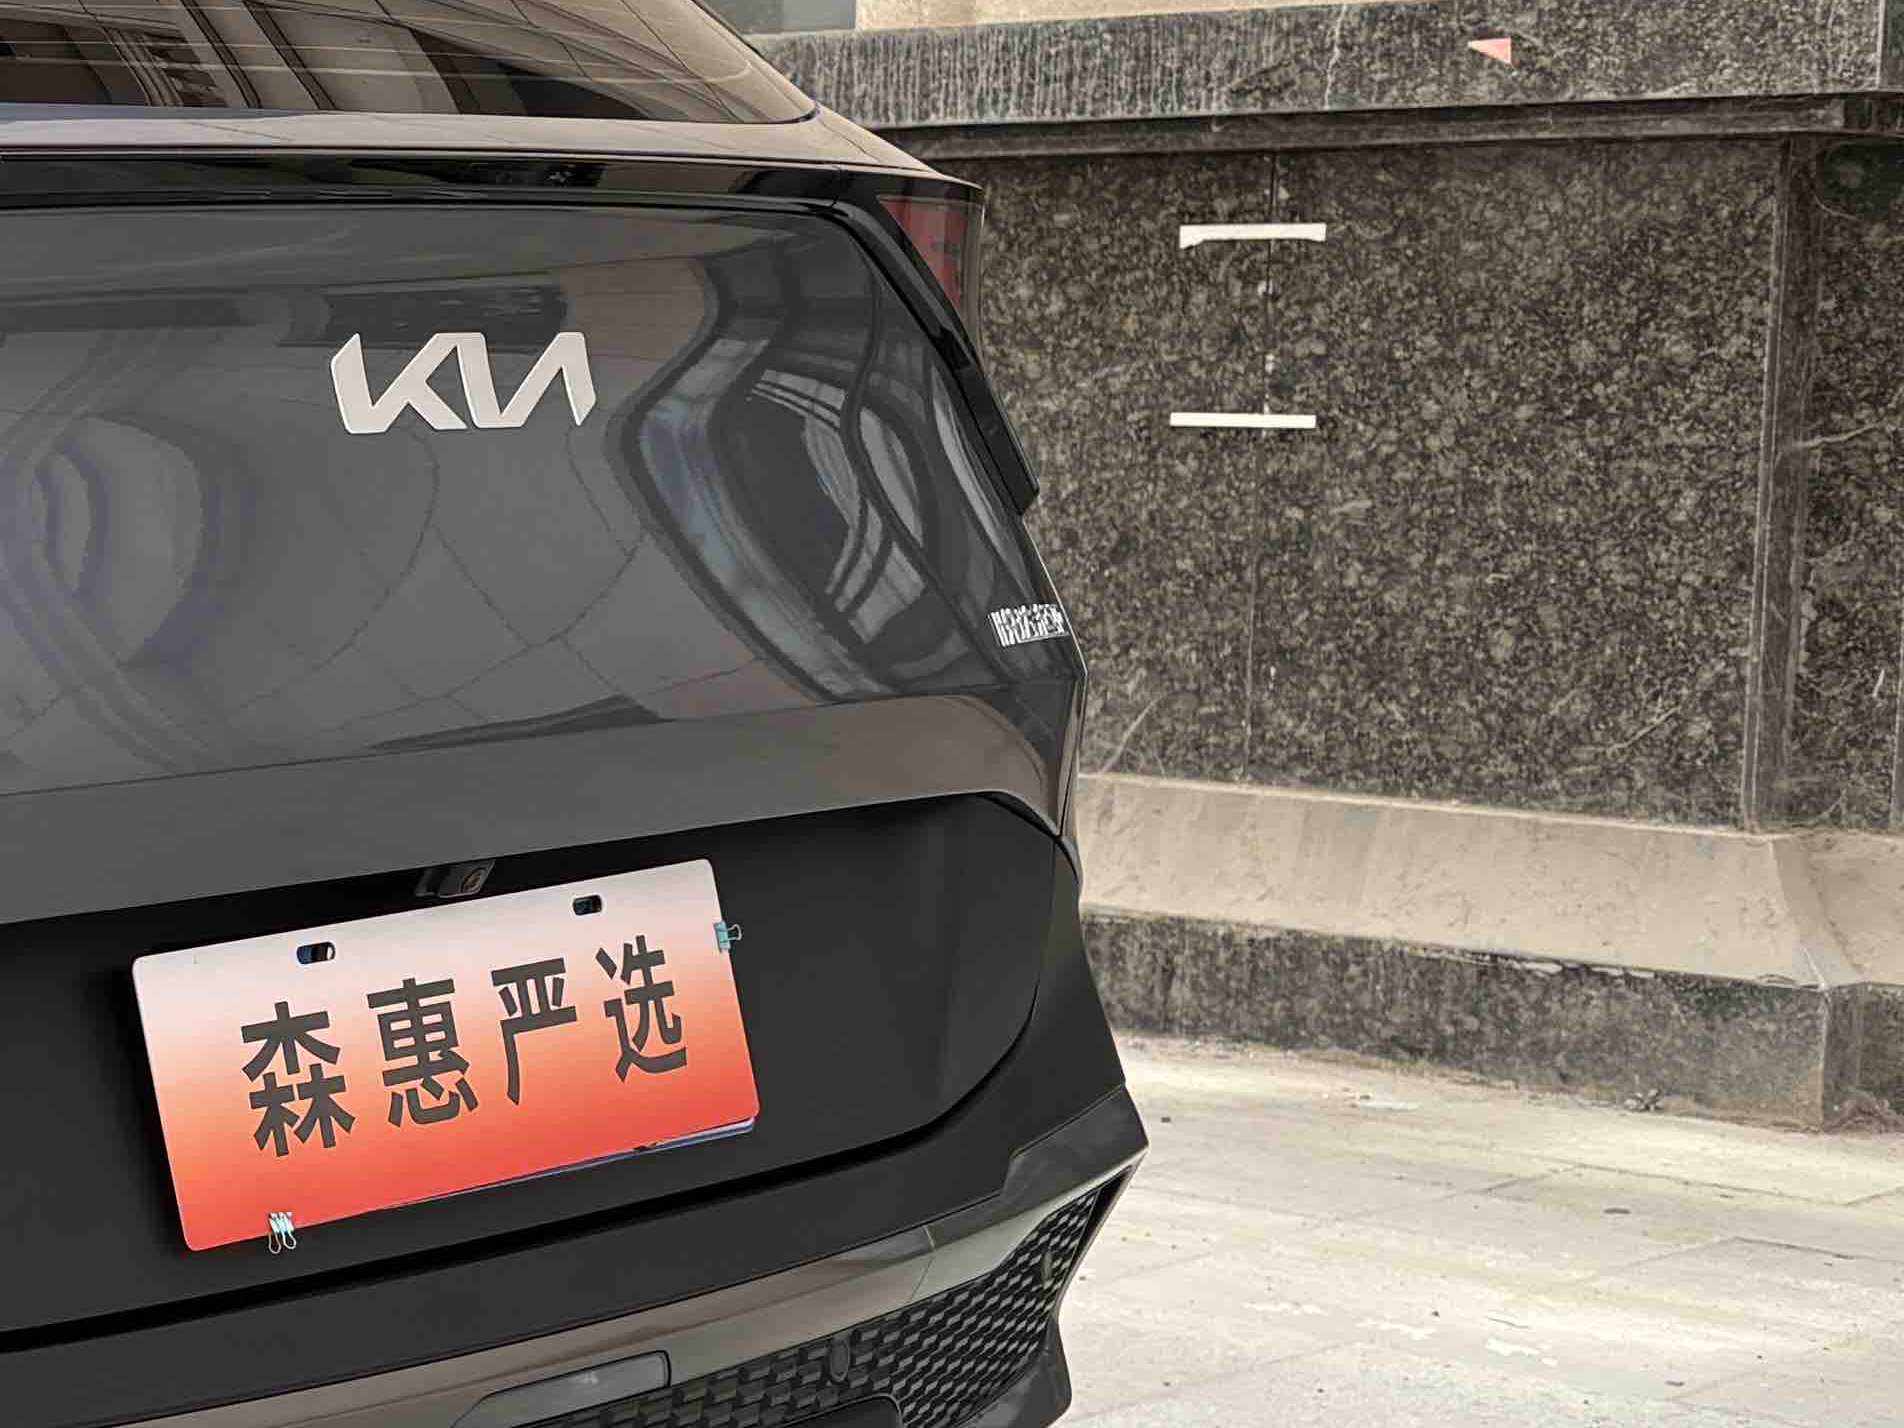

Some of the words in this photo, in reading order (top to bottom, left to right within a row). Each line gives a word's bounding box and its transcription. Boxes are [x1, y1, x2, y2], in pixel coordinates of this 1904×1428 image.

[330, 332, 597, 434] KIA
[240, 934, 688, 1158] 森惠严选
